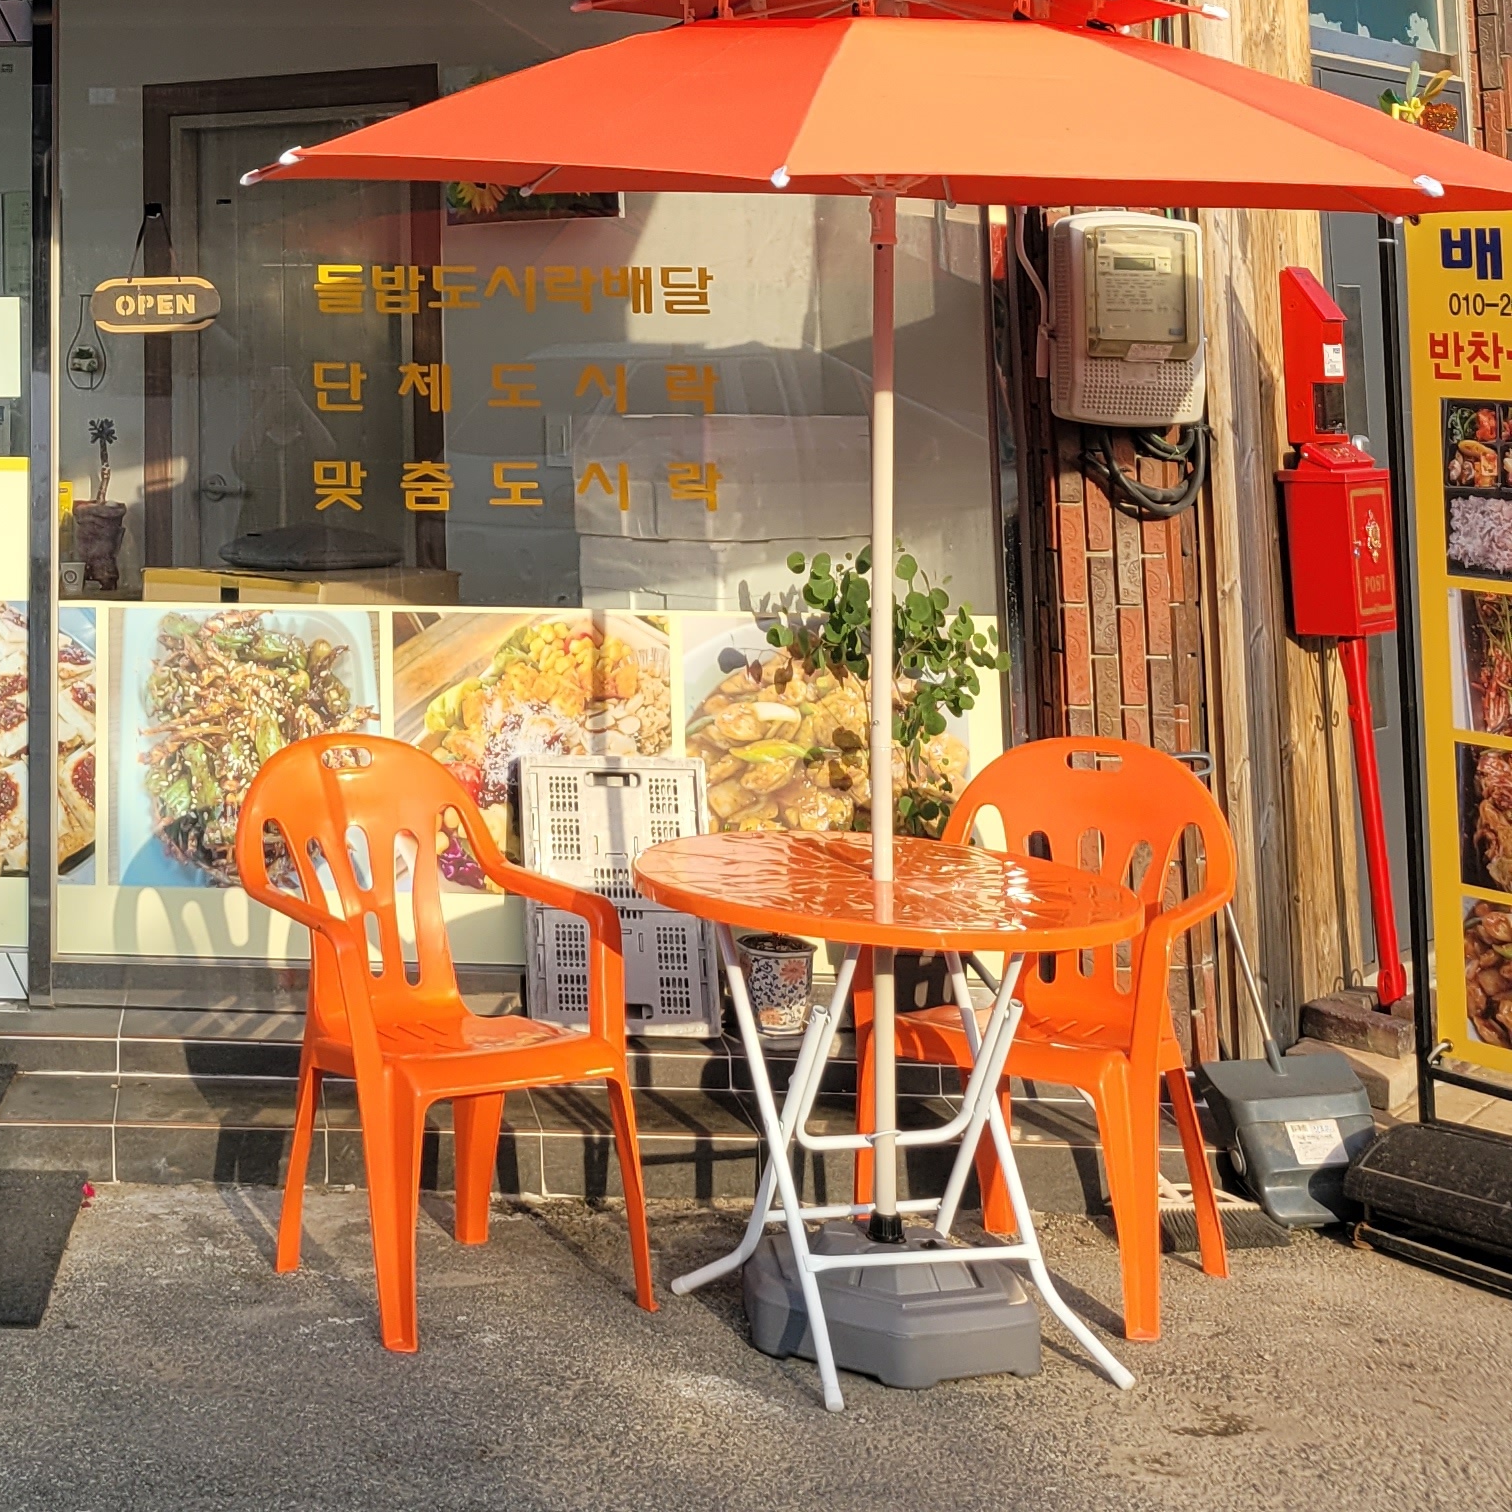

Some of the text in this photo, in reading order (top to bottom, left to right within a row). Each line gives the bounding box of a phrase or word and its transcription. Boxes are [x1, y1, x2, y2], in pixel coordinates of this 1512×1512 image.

[1441, 228, 1503, 280] 배
[114, 293, 197, 316] OPEN
[312, 264, 717, 316] 들밥도시락배달
[1448, 292, 1512, 317] 010-2
[312, 362, 721, 414] 단체도시락
[312, 460, 726, 514] 맞춤도시락
[1364, 574, 1386, 594] POST
